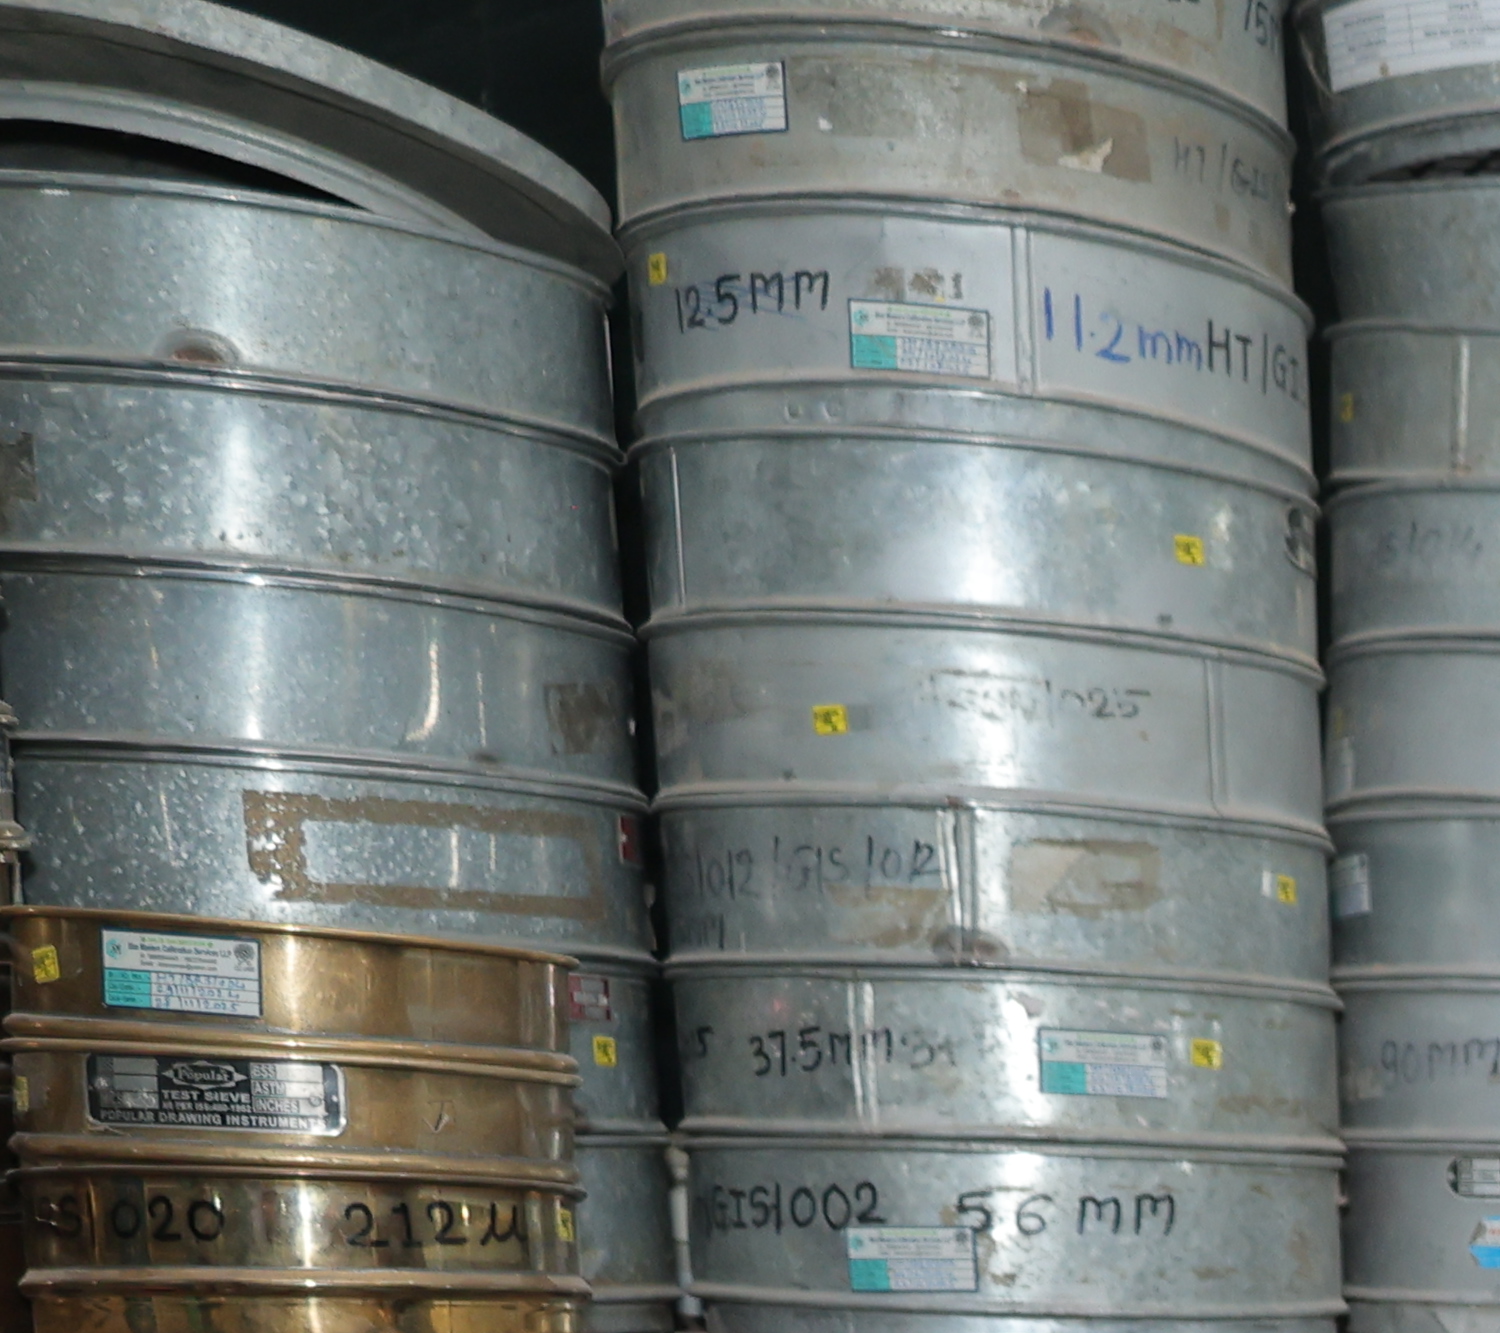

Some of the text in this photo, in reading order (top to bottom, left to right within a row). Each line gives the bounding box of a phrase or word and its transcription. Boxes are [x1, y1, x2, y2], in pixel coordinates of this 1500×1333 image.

[177, 1064, 230, 1083] Popular
[162, 1089, 250, 1104] TEST SIEVE
[251, 1097, 298, 1114] INCHES
[100, 1109, 327, 1130] POPULAR DRAWING INSTRUMENTS
